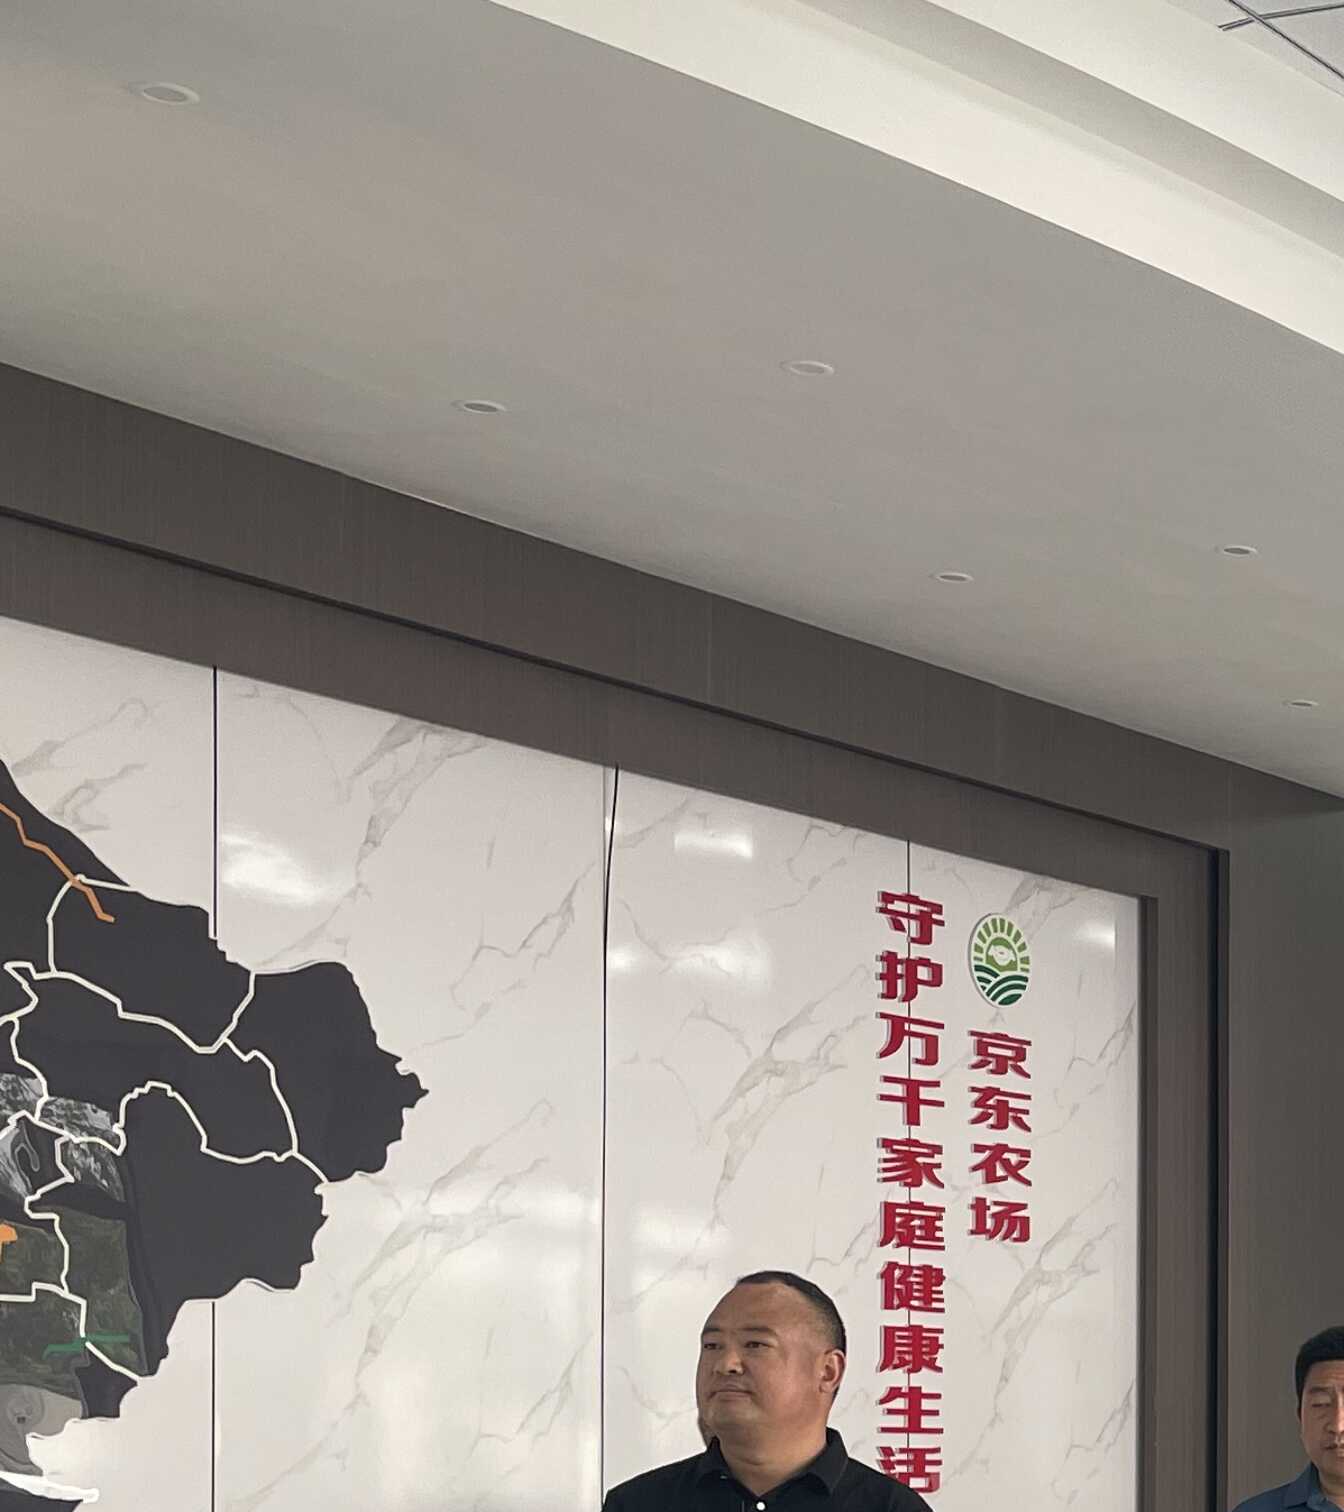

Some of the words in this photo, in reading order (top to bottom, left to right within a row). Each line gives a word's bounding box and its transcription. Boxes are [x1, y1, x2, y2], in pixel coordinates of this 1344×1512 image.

[875, 890, 947, 1495] 守护万千家庭健康生活
[967, 1029, 1033, 1244] 京东农场
